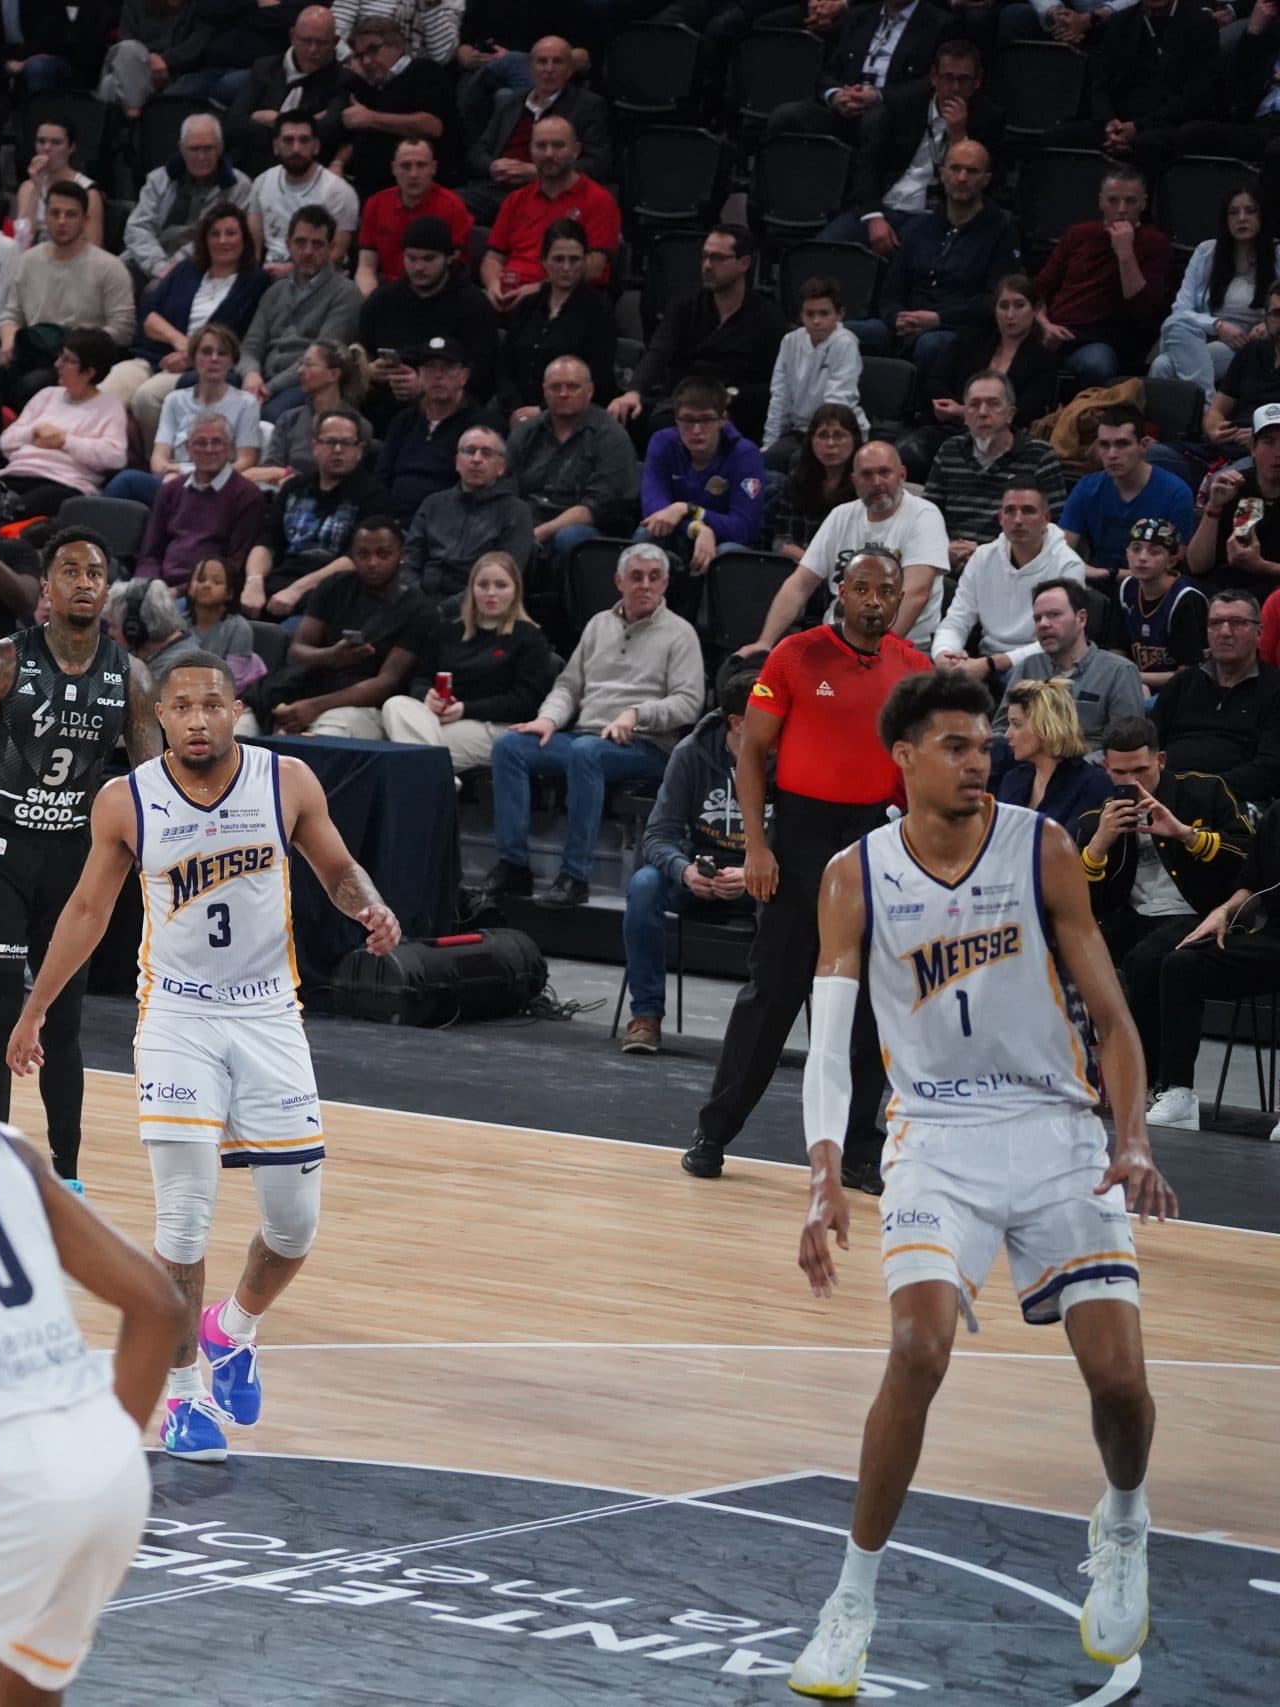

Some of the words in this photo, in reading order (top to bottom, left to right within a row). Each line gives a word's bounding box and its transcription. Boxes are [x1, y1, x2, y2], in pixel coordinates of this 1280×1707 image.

[816, 689, 835, 697] PEAK
[60, 710, 104, 729] LDLC
[58, 726, 101, 741] ASVEL
[42, 747, 74, 786] 3
[25, 787, 86, 807] SMART
[14, 803, 73, 822] GOOD
[167, 846, 274, 914] METS92
[206, 902, 232, 949] 3
[911, 926, 1019, 1000] METS92
[162, 977, 213, 1000] IDEC
[215, 976, 281, 1001] SPORT
[956, 989, 972, 1037] 1
[156, 1082, 198, 1101] idex
[912, 1078, 972, 1099] IDEC
[974, 1072, 1057, 1095] SPOT
[896, 1208, 942, 1228] idex
[667, 1608, 801, 1645] la
